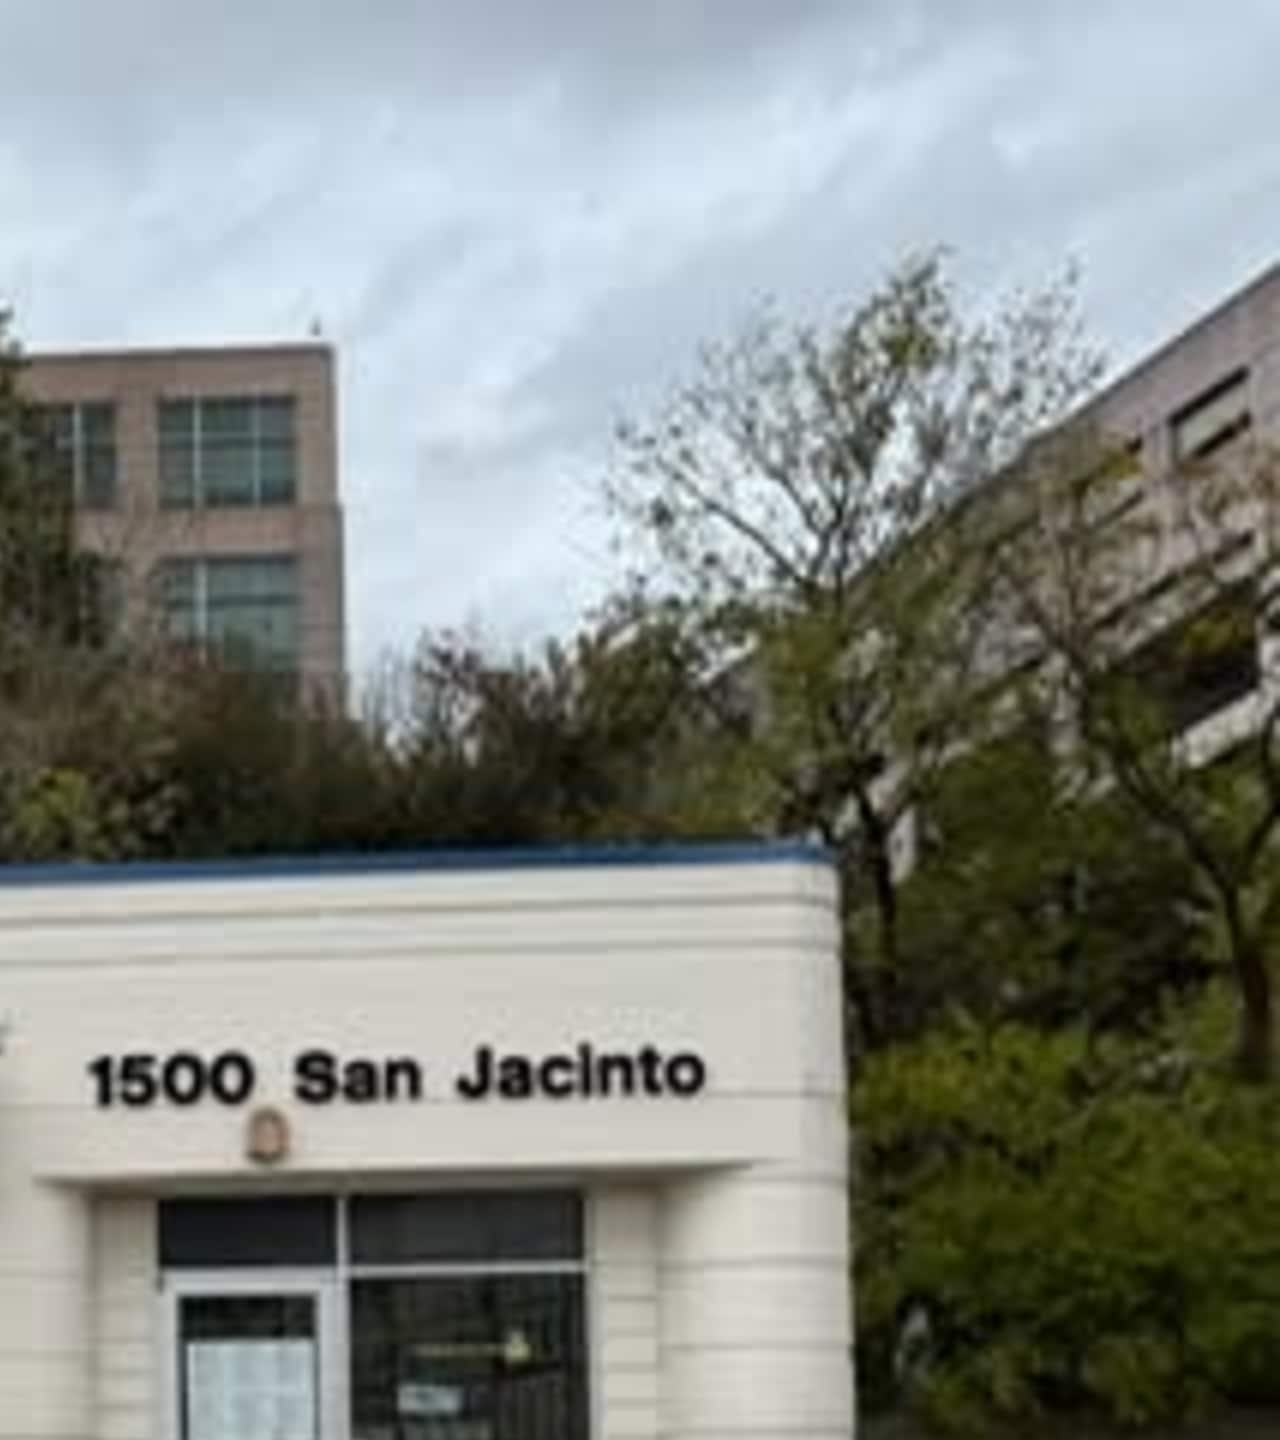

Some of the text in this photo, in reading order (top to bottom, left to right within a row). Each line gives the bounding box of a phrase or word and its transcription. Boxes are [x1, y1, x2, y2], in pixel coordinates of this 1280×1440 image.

[87, 1043, 706, 1107] 1500 San Jacinto
